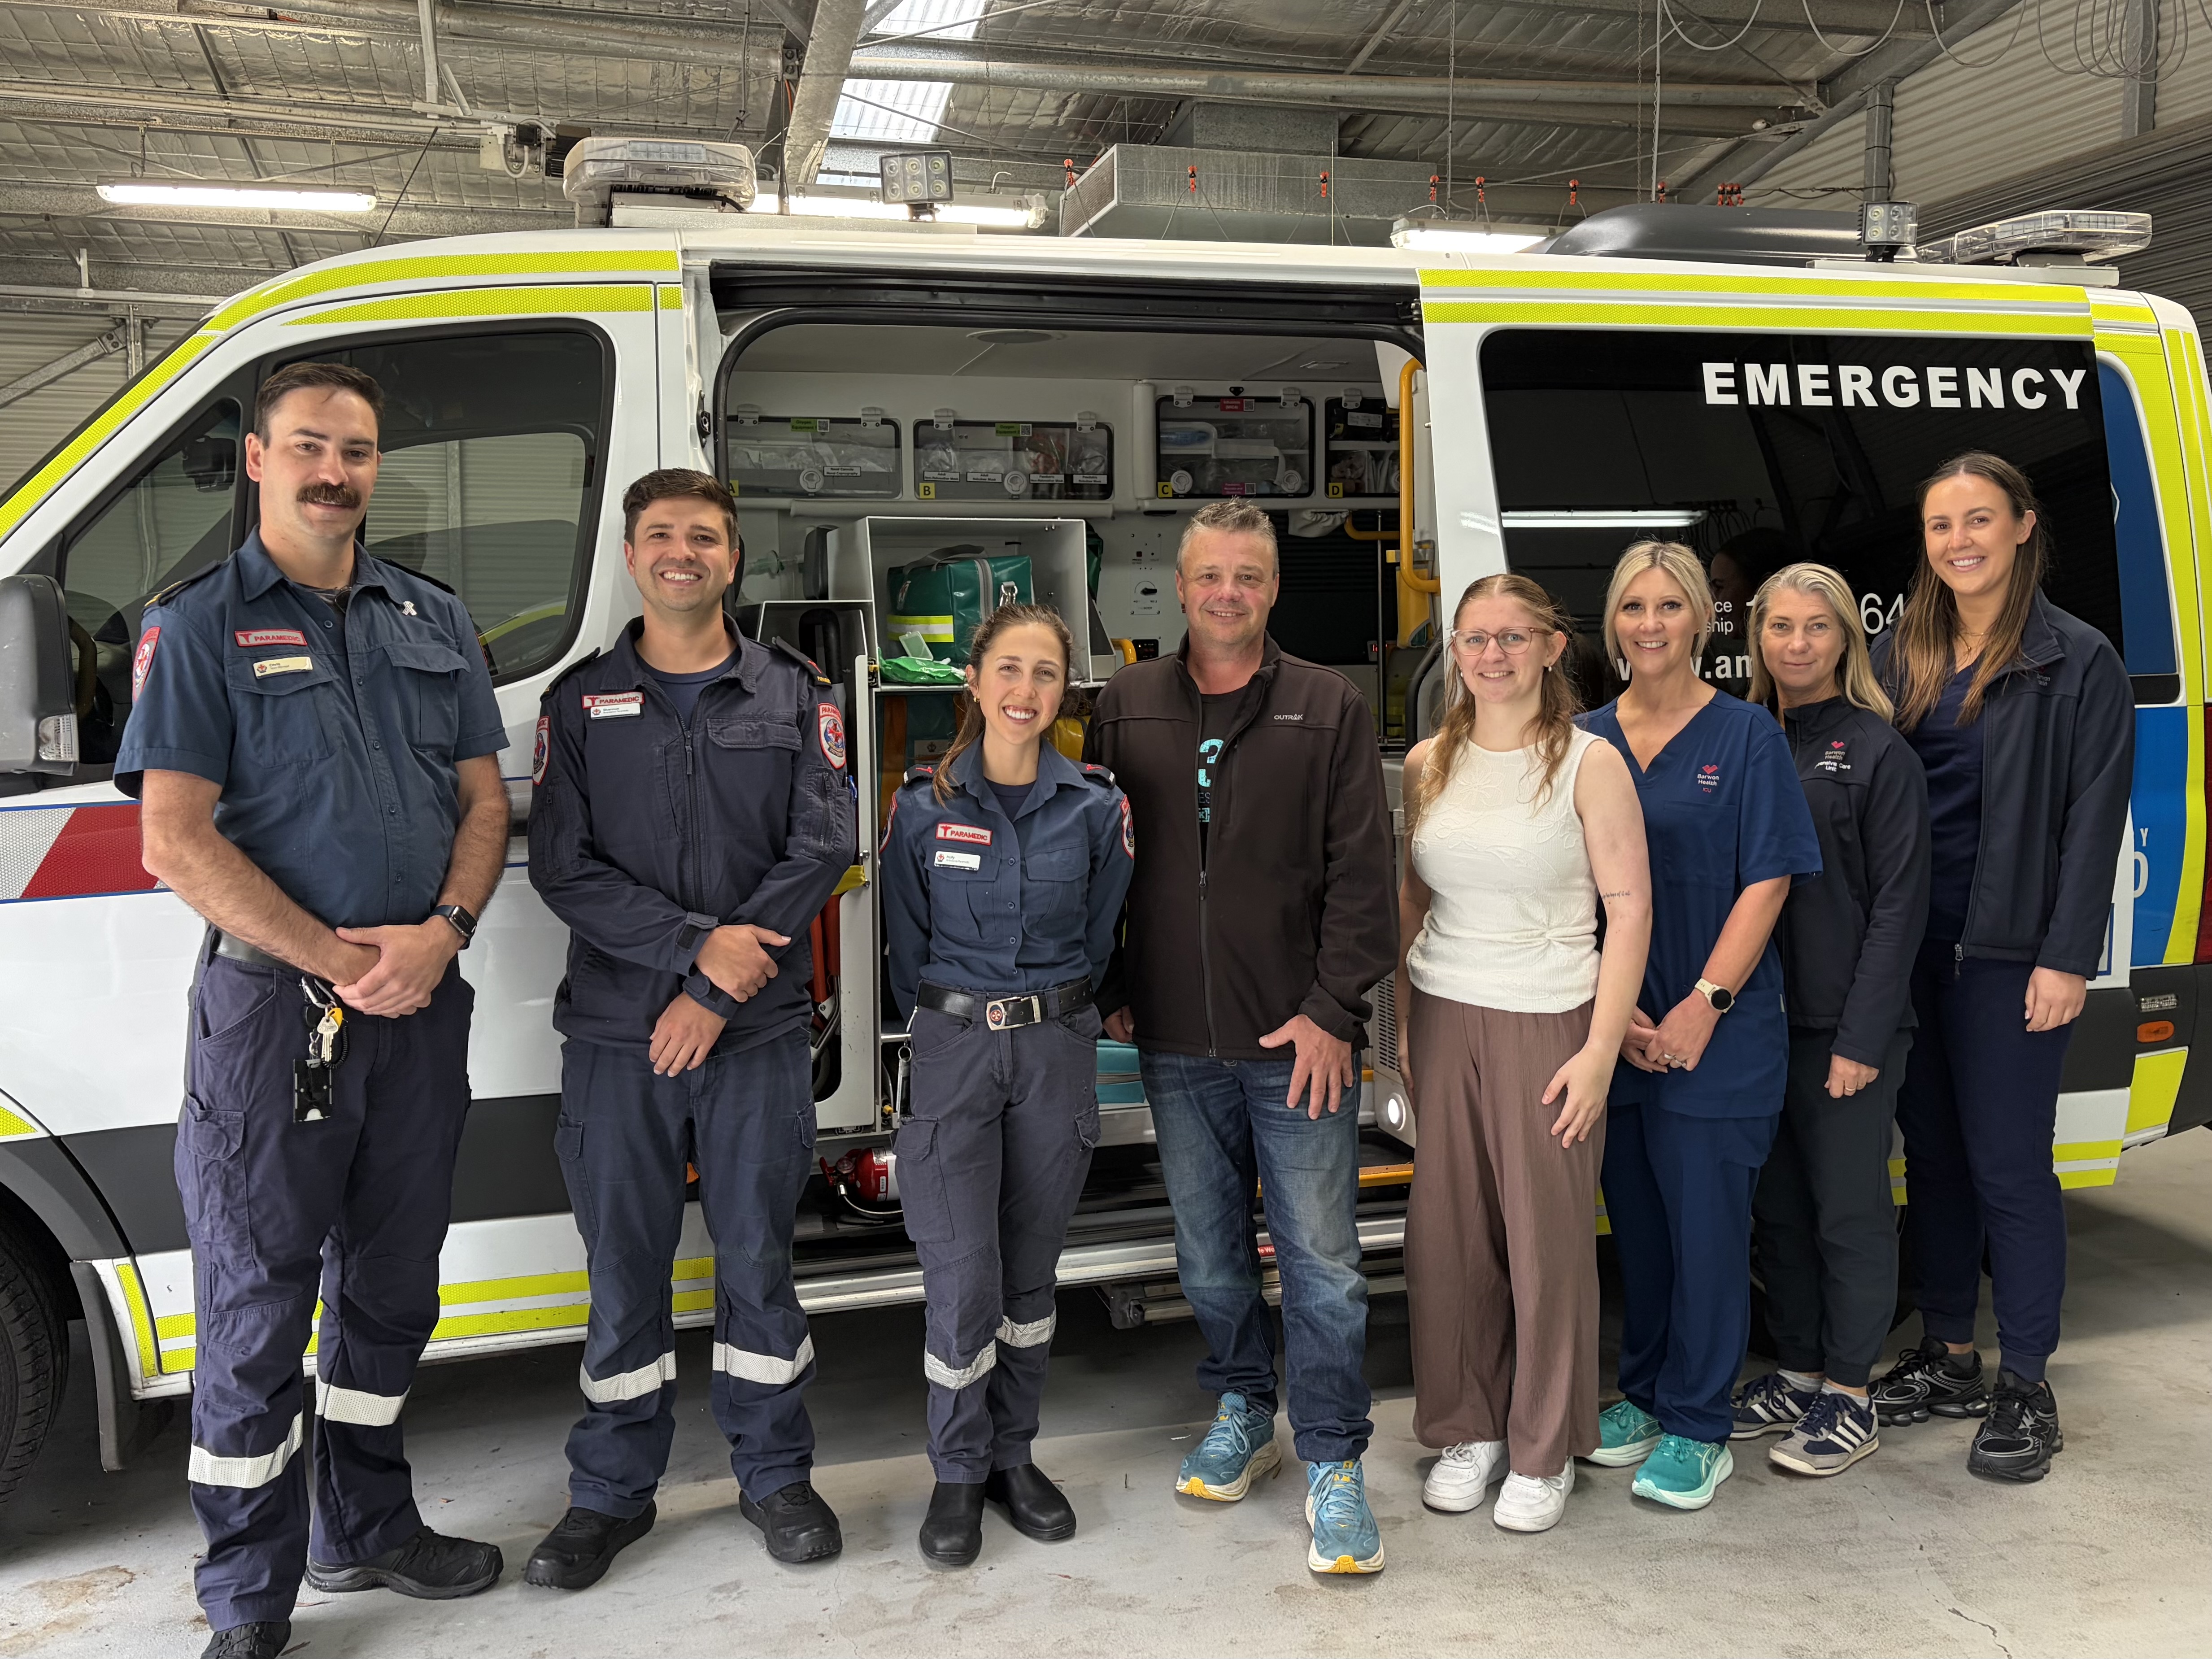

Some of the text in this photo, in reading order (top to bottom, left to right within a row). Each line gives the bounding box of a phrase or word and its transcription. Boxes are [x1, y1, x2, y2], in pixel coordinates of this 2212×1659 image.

[1702, 362, 2086, 409] EMERGENCY
[923, 485, 931, 496] B
[1161, 484, 1169, 495] C
[1331, 485, 1340, 496] D
[599, 696, 640, 705] PARAMEDIC
[950, 830, 988, 840] PARAMEDIC
[2140, 827, 2149, 847] Y
